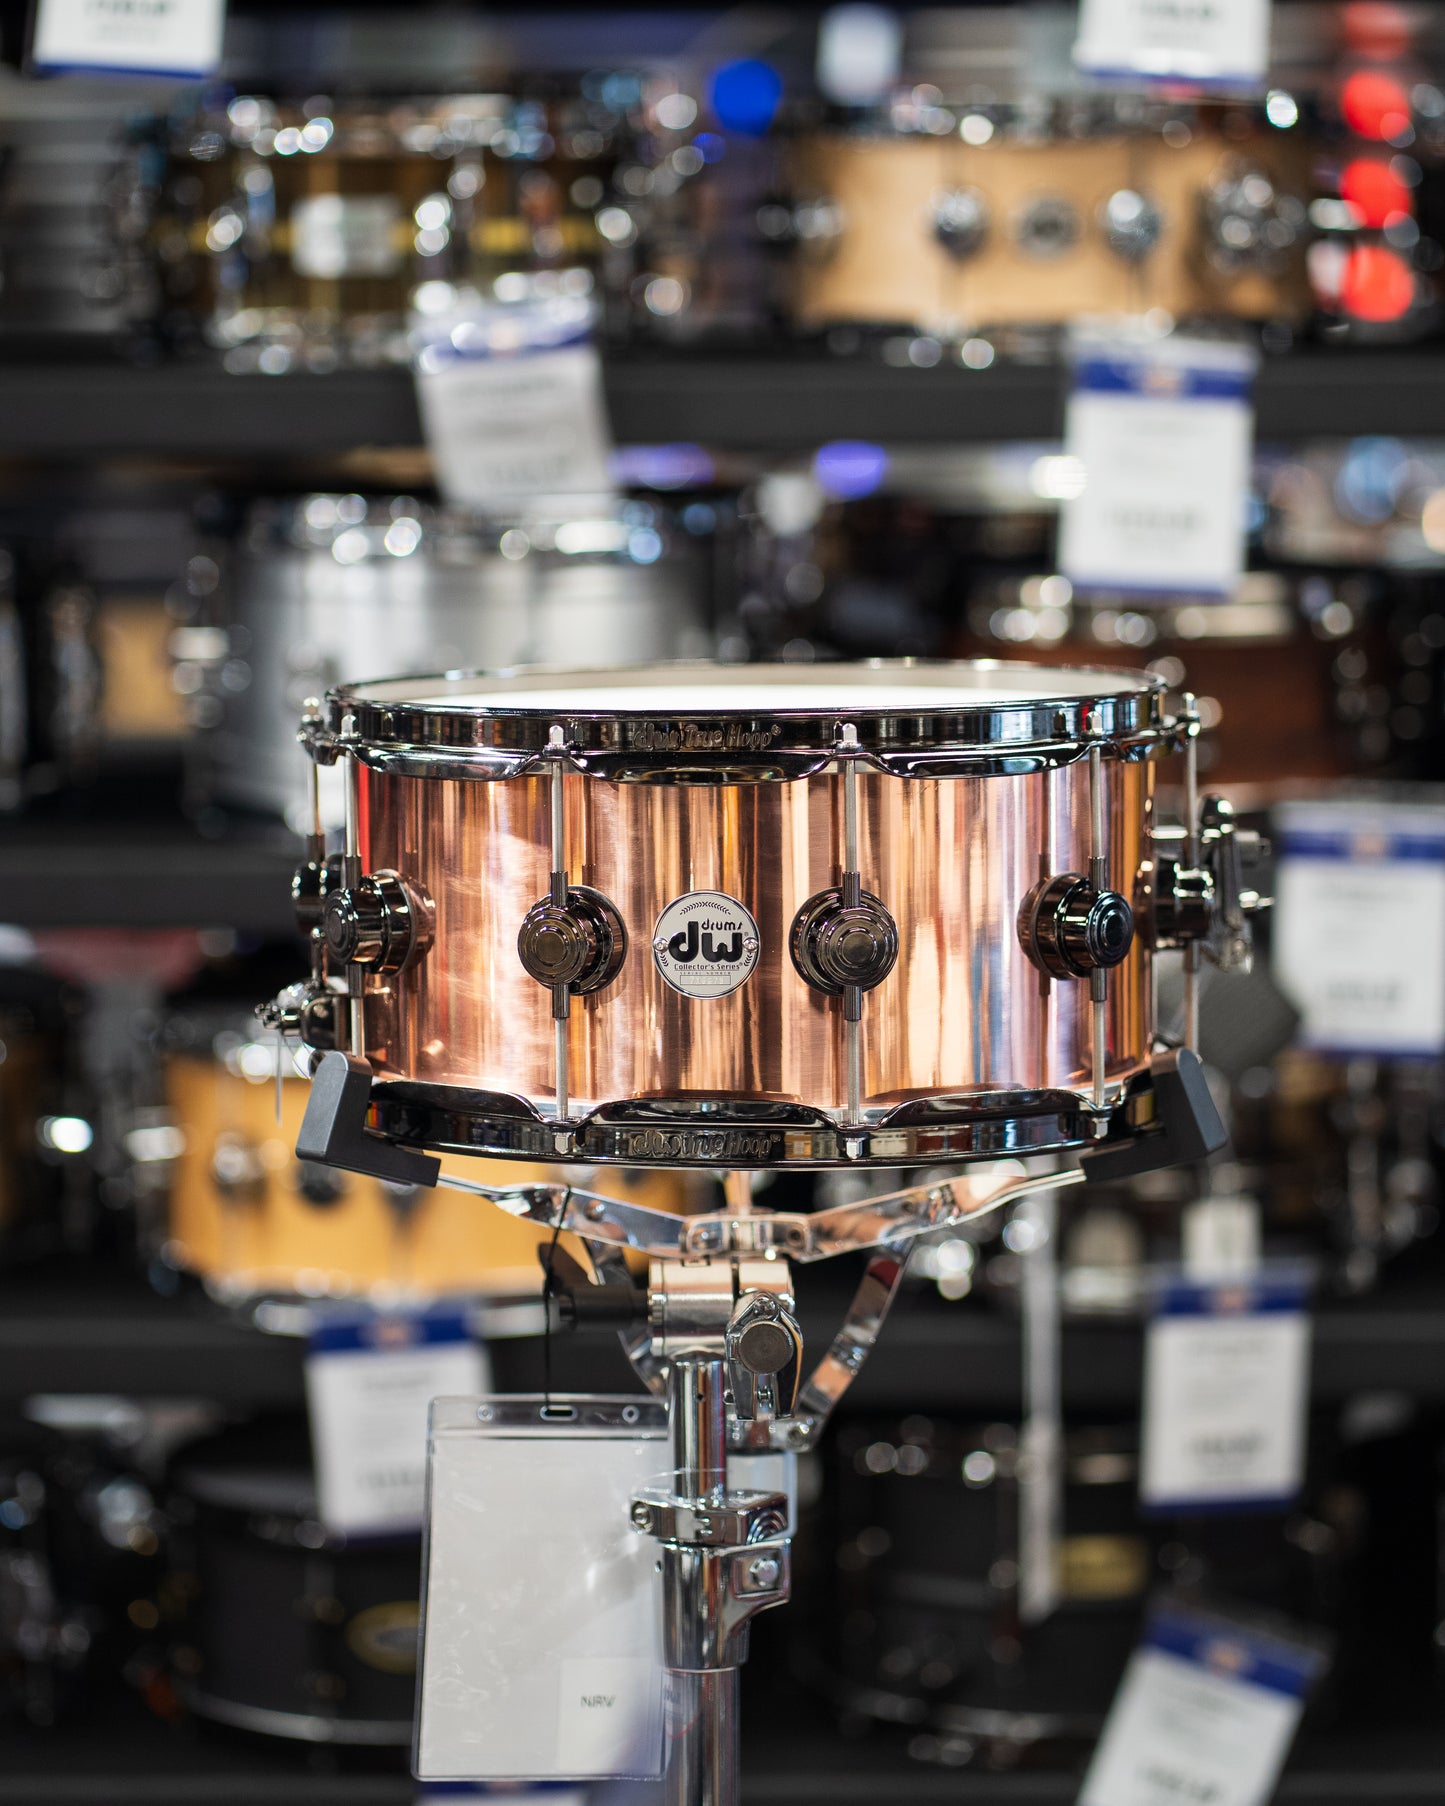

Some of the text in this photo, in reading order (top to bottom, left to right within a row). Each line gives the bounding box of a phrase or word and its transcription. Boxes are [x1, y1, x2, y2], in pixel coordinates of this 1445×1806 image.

[684, 723, 723, 748] True
[701, 918, 743, 931] drums
[668, 921, 743, 963] dw
[580, 1695, 616, 1708] NRV
